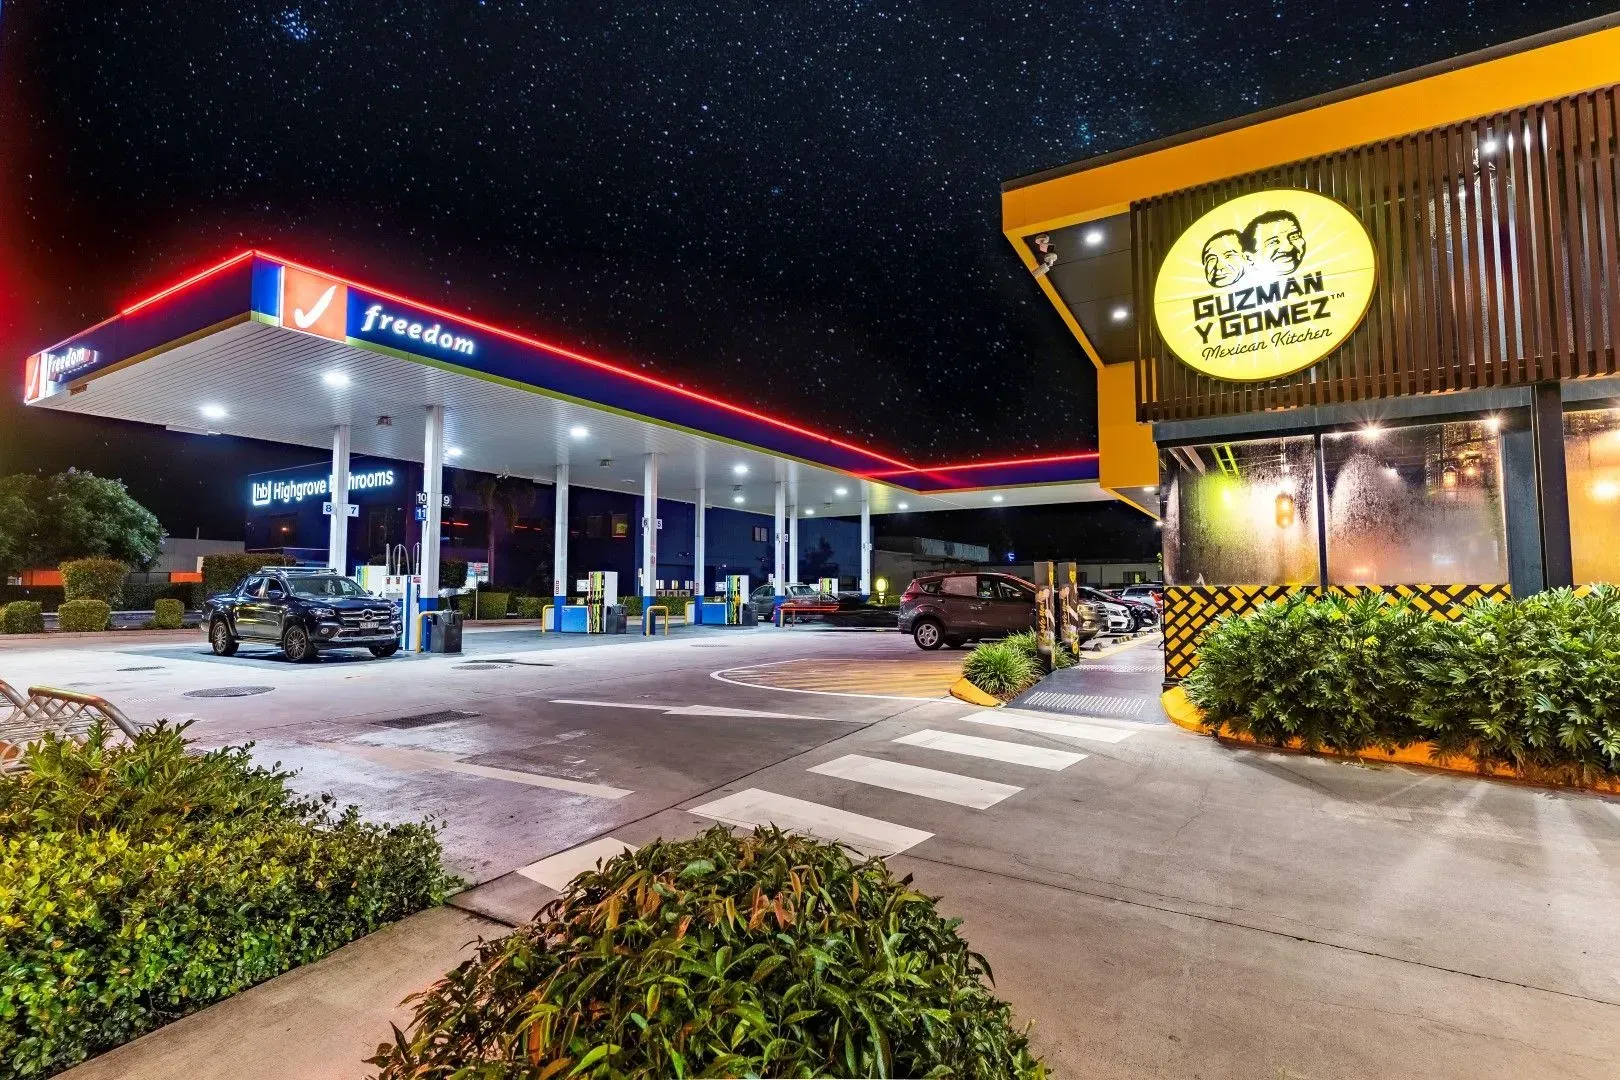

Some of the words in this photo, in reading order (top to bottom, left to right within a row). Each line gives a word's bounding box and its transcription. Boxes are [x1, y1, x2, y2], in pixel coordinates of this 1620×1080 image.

[1193, 271, 1324, 321] GUZMAN
[361, 305, 476, 354] freedom
[1194, 322, 1214, 344] Y
[1219, 296, 1331, 339] GOMEZ
[1202, 341, 1267, 361] Mexican
[1271, 327, 1333, 348] Kitchen
[273, 480, 327, 503] Highgrove
[329, 470, 394, 493] hrooms
[417, 492, 427, 502] 10
[325, 504, 332, 513] 8
[350, 506, 357, 514] 7
[443, 495, 450, 505] 9
[416, 508, 426, 518] 11
